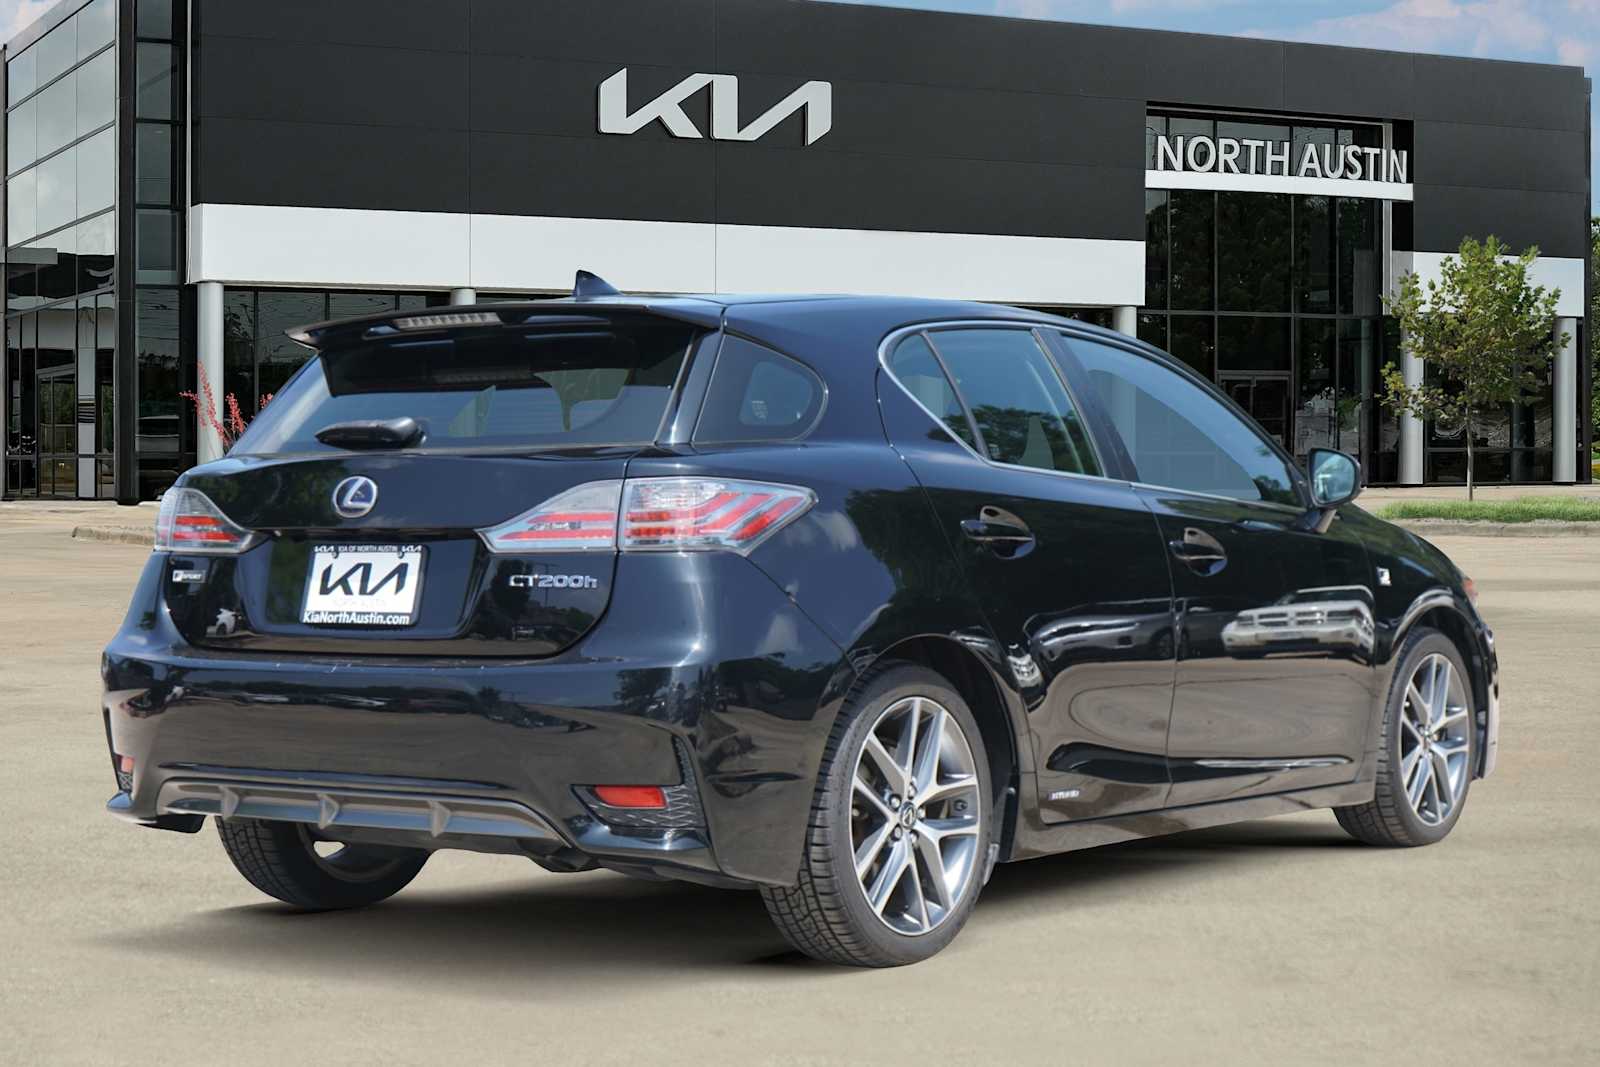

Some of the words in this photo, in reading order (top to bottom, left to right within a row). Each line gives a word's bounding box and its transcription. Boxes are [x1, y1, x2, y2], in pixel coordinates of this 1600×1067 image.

[599, 67, 832, 146] KIA
[1157, 134, 1290, 177] NORTH
[1298, 142, 1408, 184] AUSTIN
[319, 562, 409, 596] KIA
[302, 610, 410, 626] KiaNorthAustin.com
